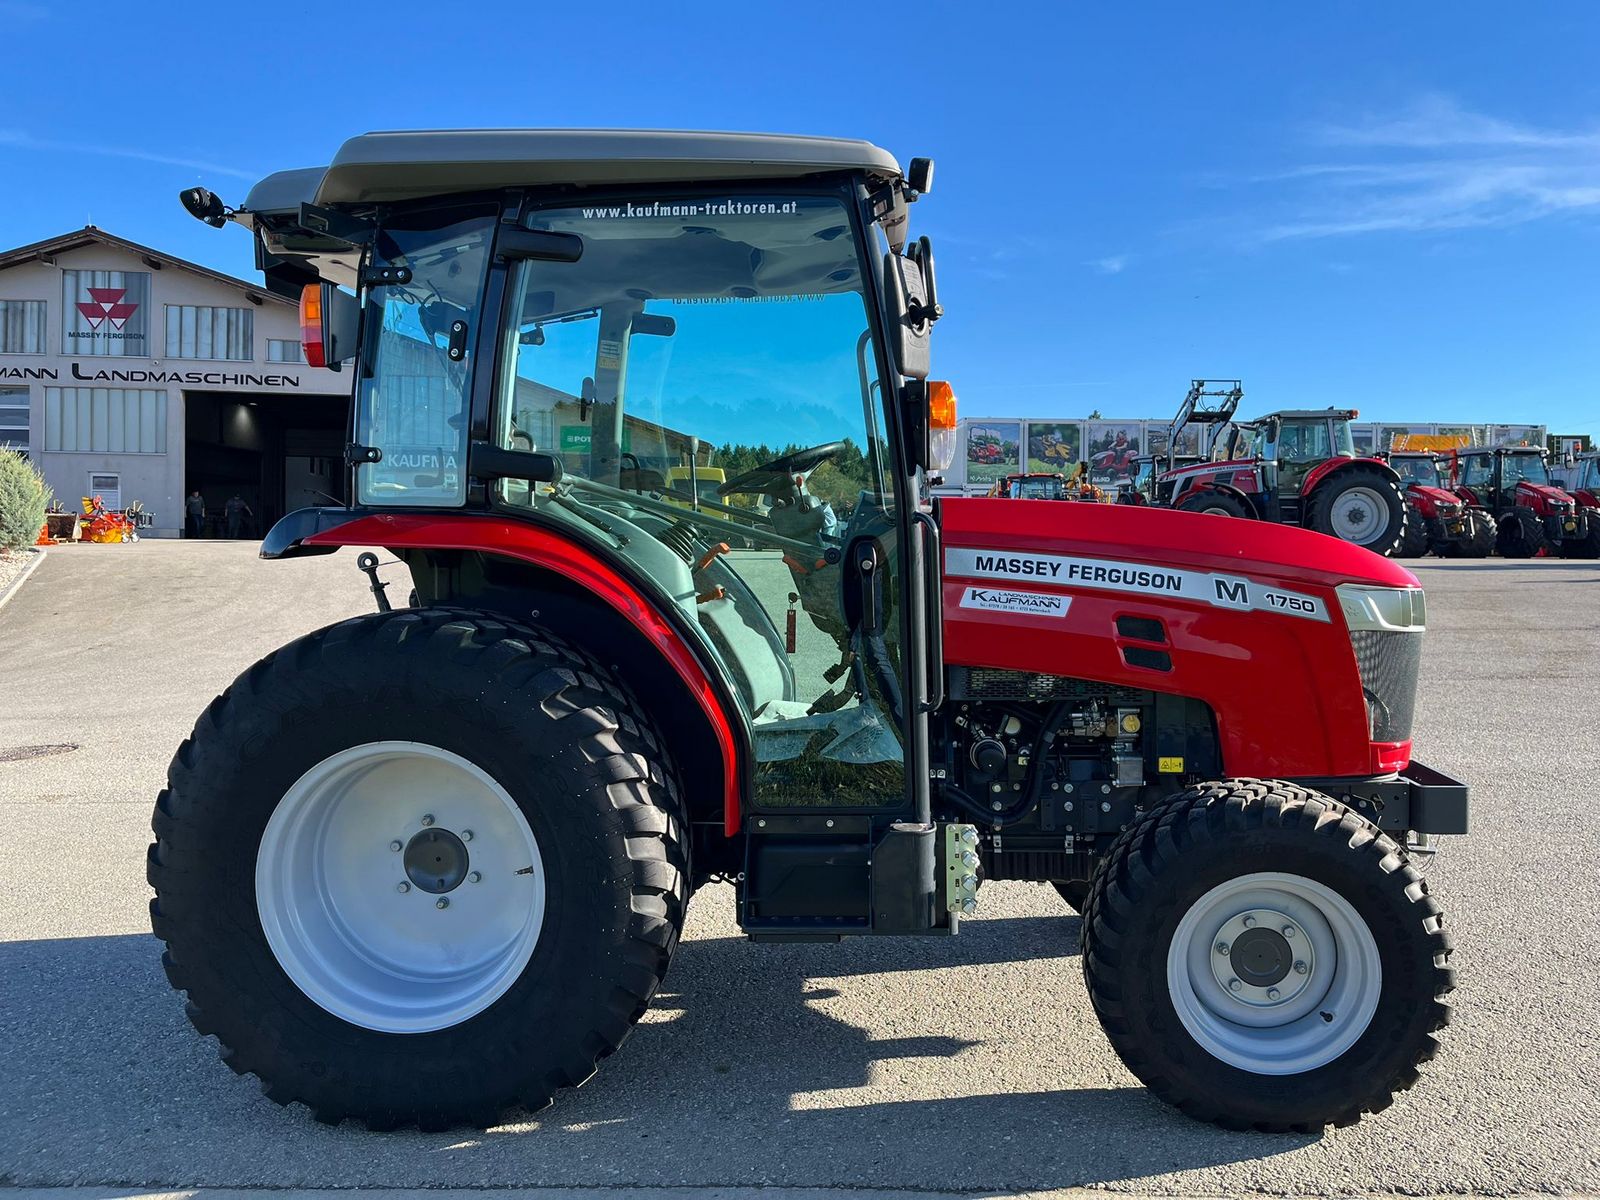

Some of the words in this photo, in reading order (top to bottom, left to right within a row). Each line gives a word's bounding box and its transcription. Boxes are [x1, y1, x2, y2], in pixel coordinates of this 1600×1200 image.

[582, 200, 797, 219] www.kaufmann-traktoren.at
[68, 331, 101, 339] MASSEY
[103, 332, 145, 340] FERGUSON
[71, 362, 300, 387] LANDMASCHINEN
[975, 556, 1062, 577] MASSEY
[1068, 564, 1182, 591] FERGUSON
[1214, 579, 1249, 604] M
[1265, 593, 1316, 613] 1750
[971, 589, 1061, 609] KAUFMANN
